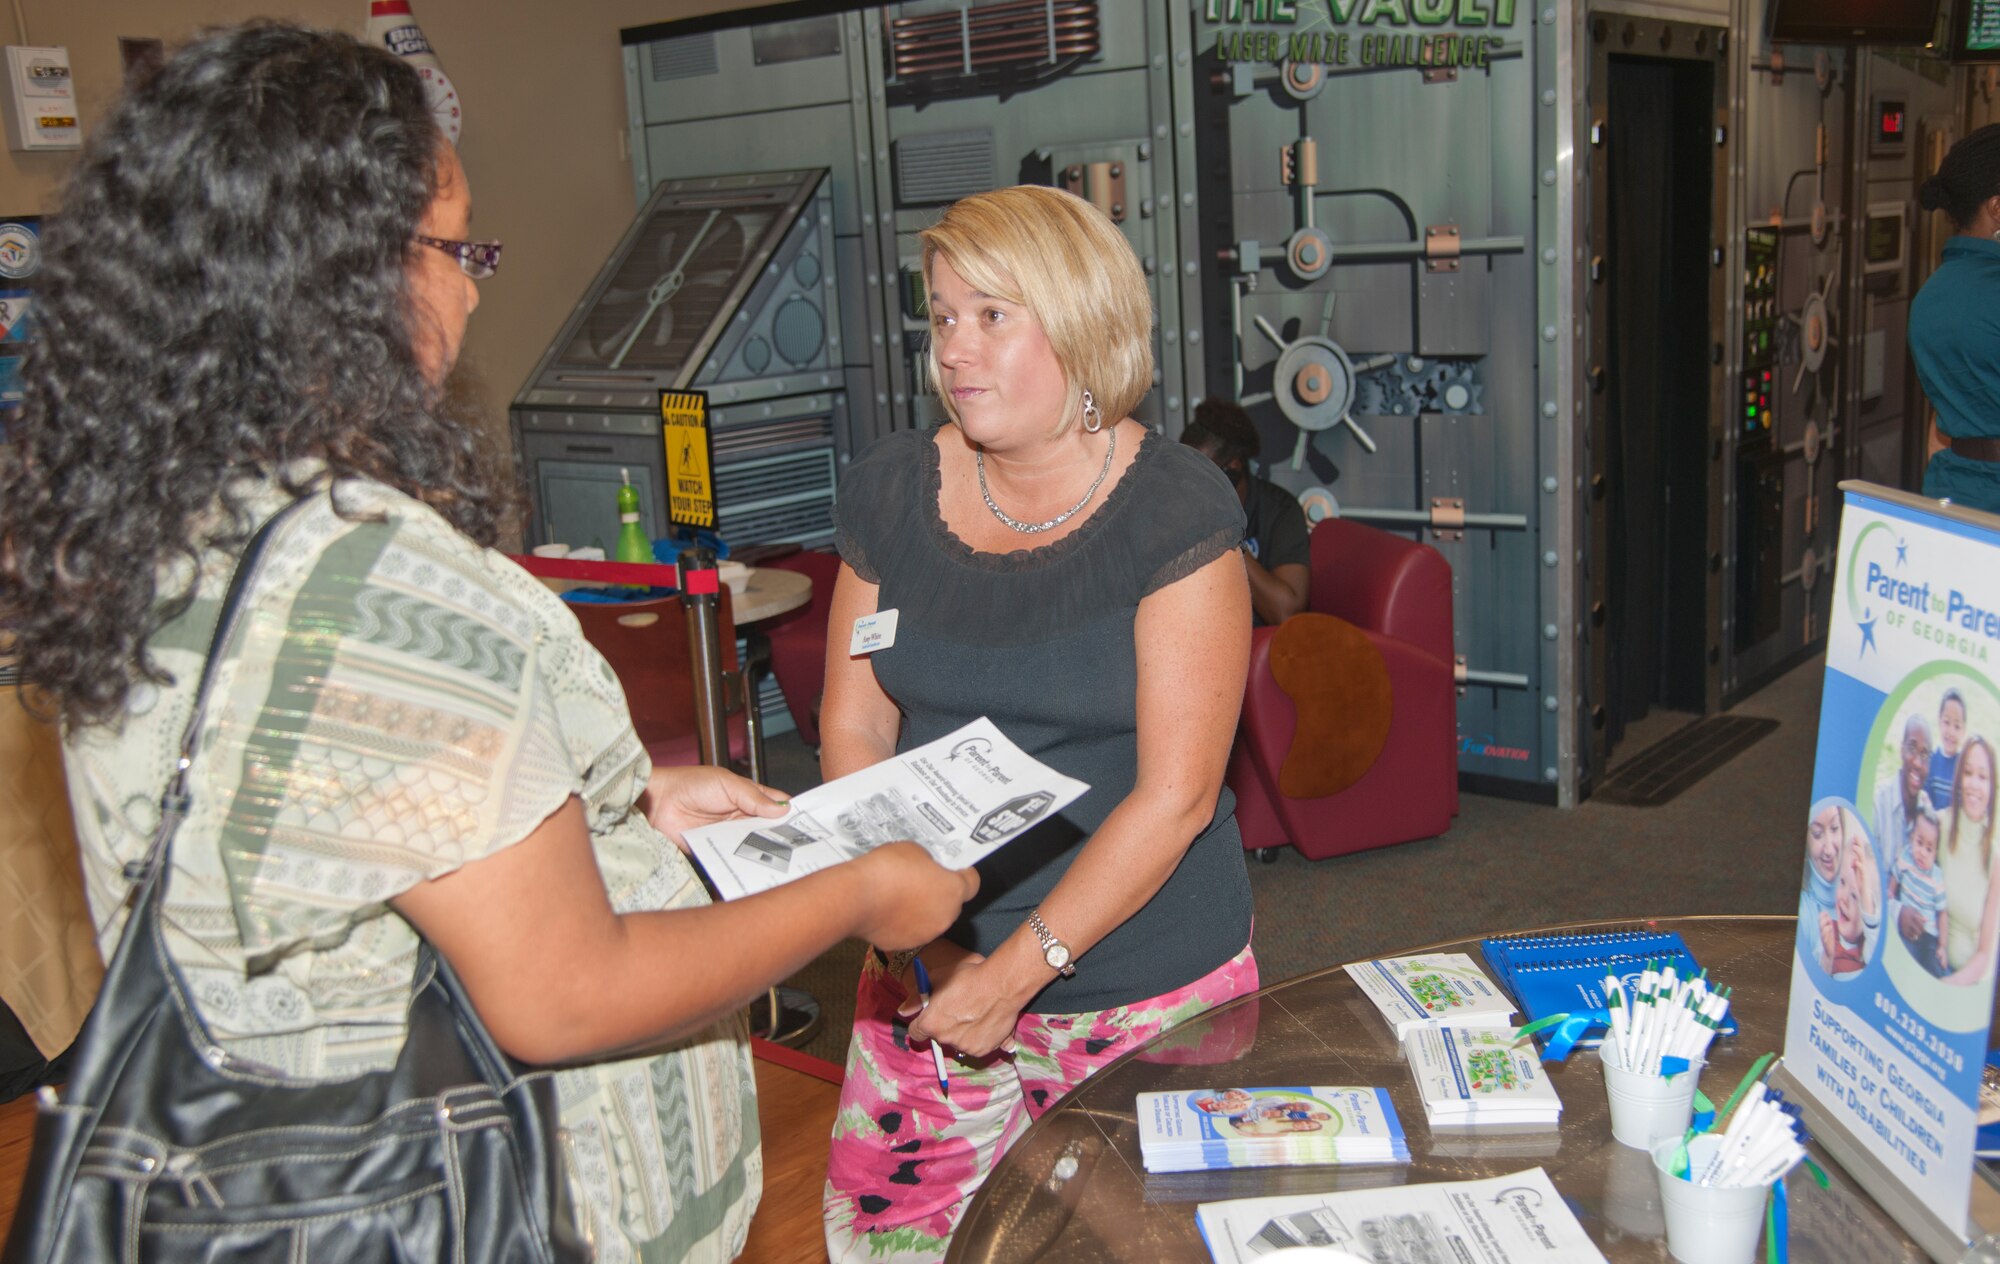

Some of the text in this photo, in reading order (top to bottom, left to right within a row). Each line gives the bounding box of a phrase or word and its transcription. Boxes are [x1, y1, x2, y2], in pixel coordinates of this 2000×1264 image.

[1216, 31, 1279, 61] LASER
[1288, 32, 1349, 64] MAZE
[671, 413, 699, 428] CAUTION
[672, 496, 712, 514] YOUR STEP
[677, 478, 704, 495] WATCH
[1866, 561, 2000, 641] Parent to Pare
[1886, 610, 1989, 663] OF GEORGIA
[965, 745, 990, 766] Parent
[988, 766, 1014, 785] Parent
[1813, 998, 1945, 1127] SUPPORTING GEORGIA
[1349, 1093, 1362, 1111] Parent
[1357, 1115, 1371, 1134] Parent
[1809, 1024, 1944, 1160] FAMILIES OF CHILDREN
[1817, 1063, 1927, 1176] WITH DISABILITIES
[1512, 1195, 1536, 1219] Parent
[1534, 1224, 1558, 1250] Parent
